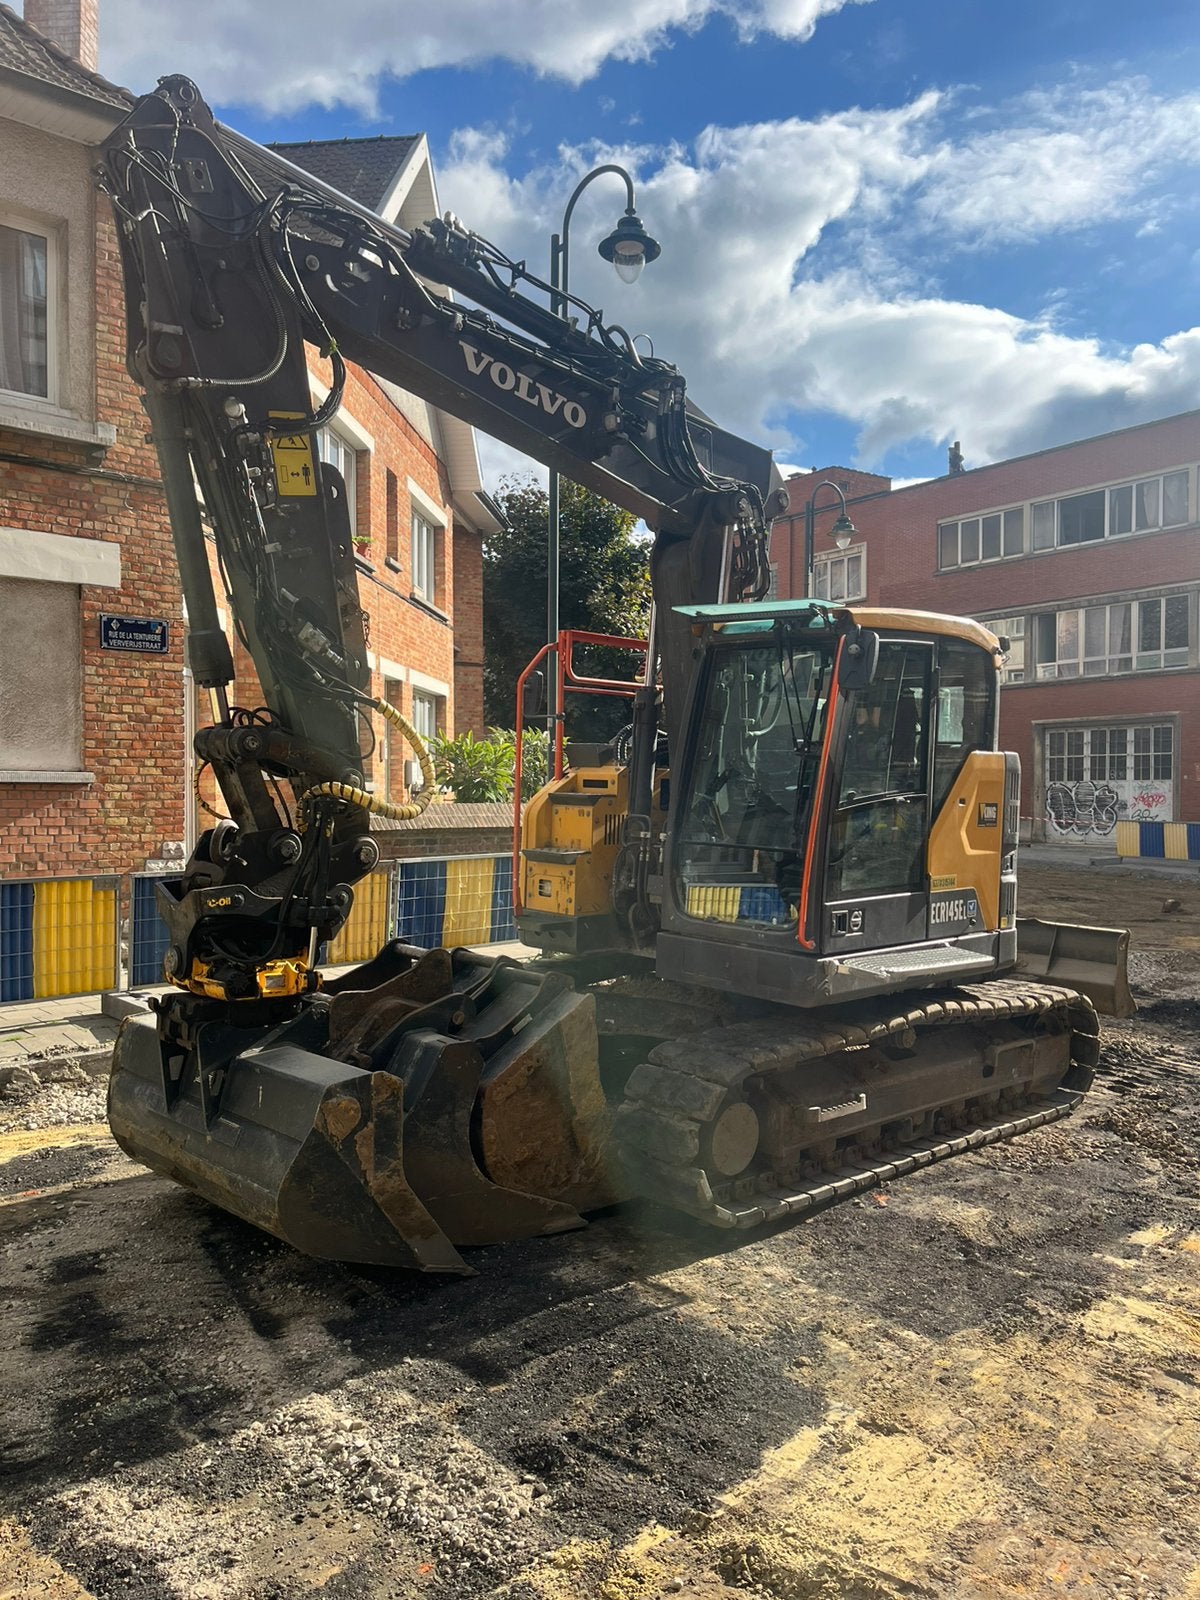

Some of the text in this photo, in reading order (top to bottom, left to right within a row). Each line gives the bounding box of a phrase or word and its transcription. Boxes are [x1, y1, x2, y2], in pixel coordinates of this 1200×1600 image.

[459, 340, 587, 428] VOLVO
[126, 632, 133, 640] LA
[109, 639, 161, 649] VERVERIJSTRAAT
